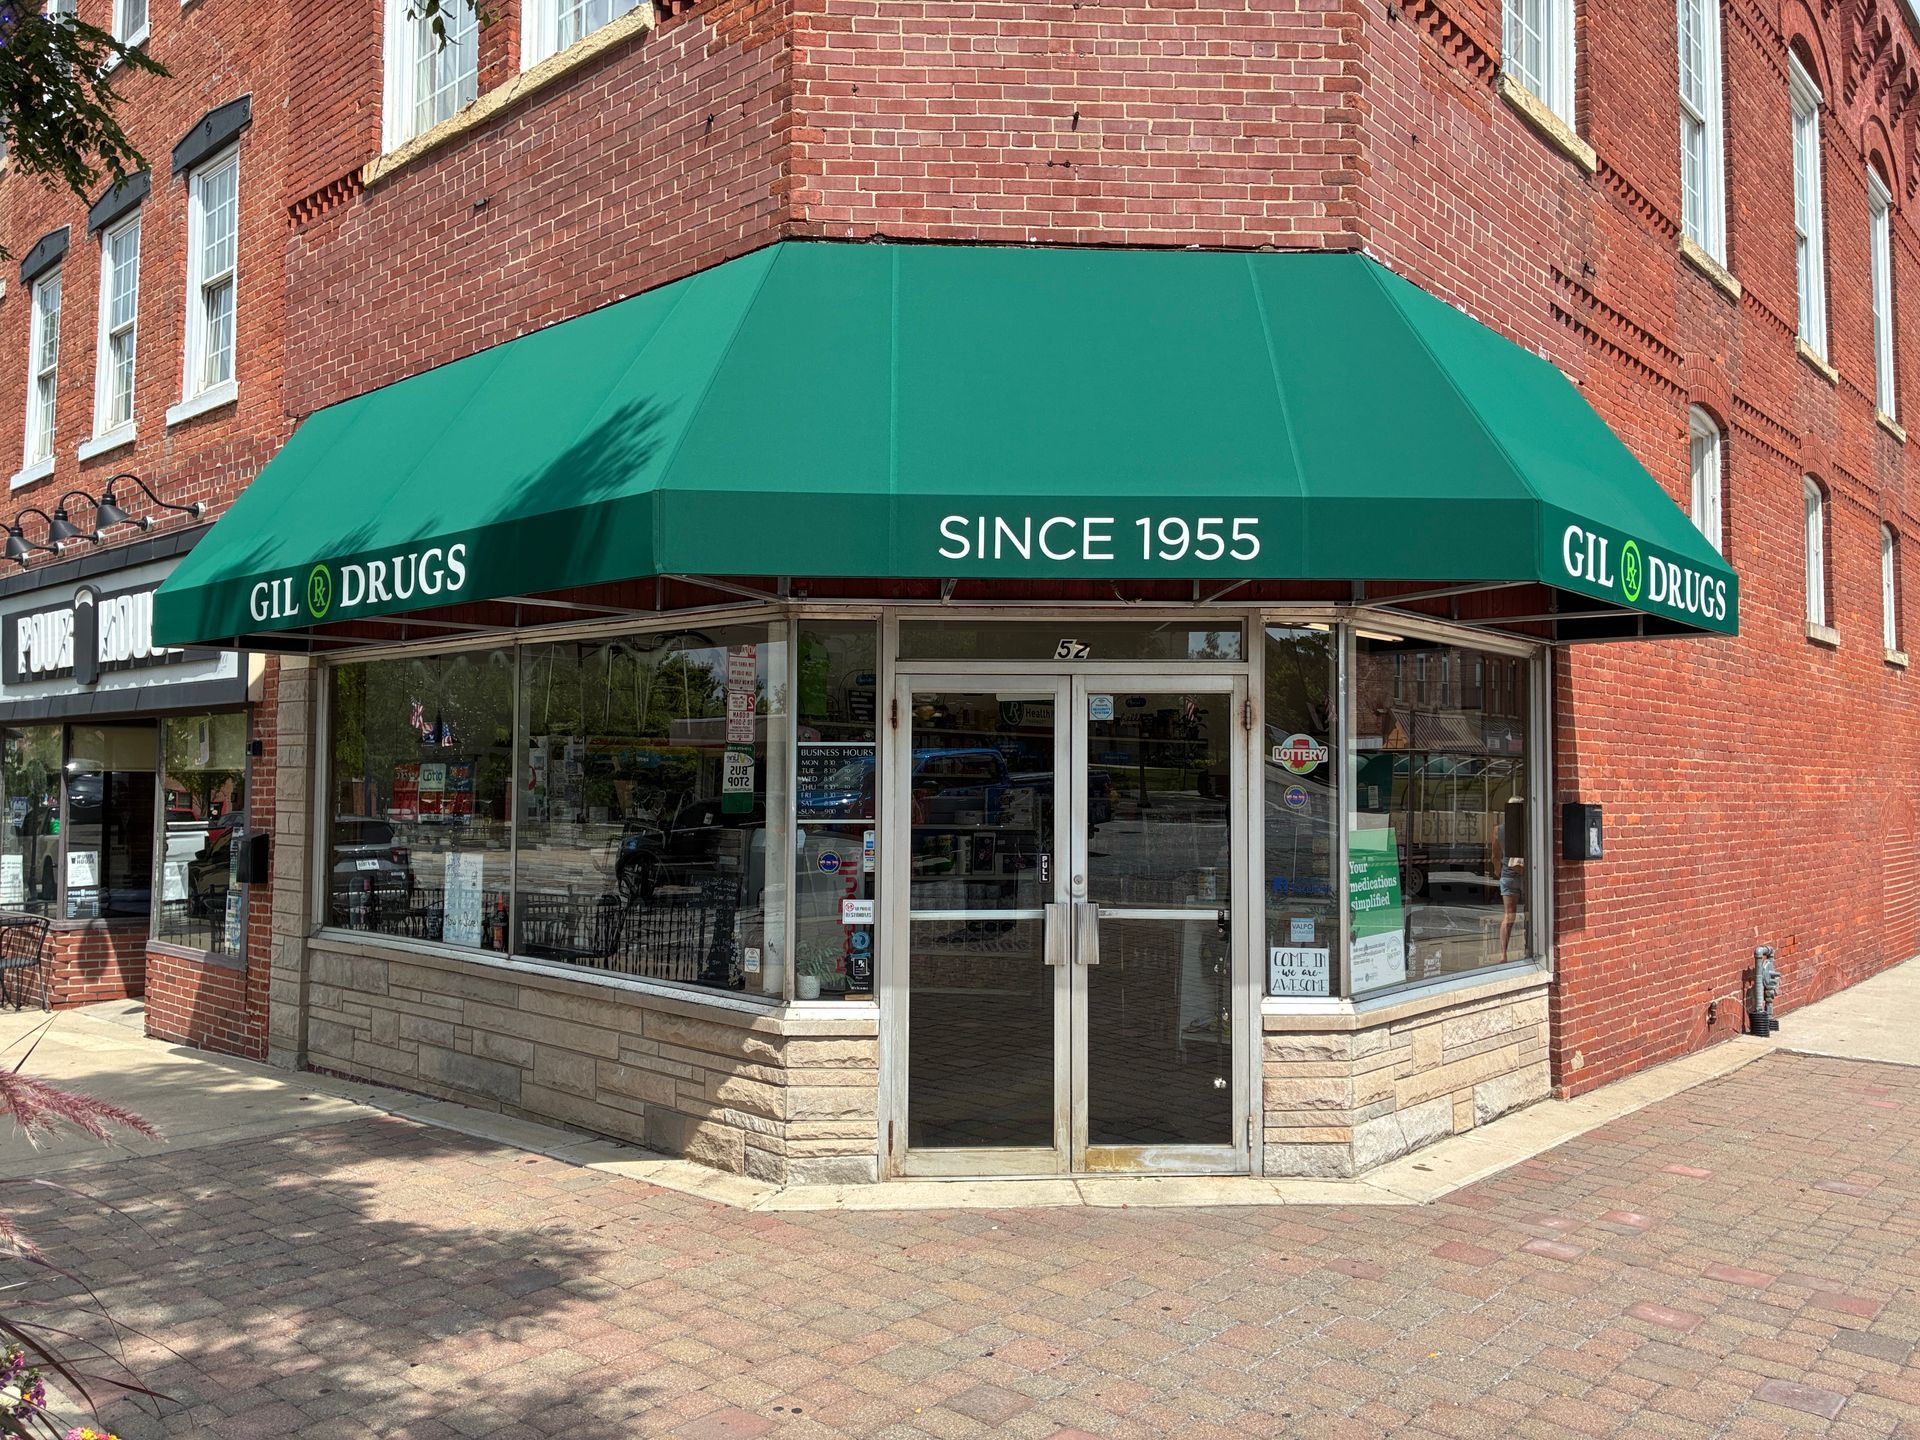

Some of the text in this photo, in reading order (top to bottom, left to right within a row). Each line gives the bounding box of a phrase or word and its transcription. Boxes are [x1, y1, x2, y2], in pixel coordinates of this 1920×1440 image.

[938, 515, 1261, 561] SINCE 1955
[1563, 525, 1614, 588] GIL
[1648, 555, 1726, 621] DRUGS
[250, 577, 299, 622] GIL
[340, 543, 466, 608] DRUGS
[17, 589, 185, 674] POUR HOU
[1057, 640, 1090, 659] 52
[1025, 708, 1051, 719] Health
[801, 749, 874, 757] BUSINESS HOURS
[1275, 748, 1326, 761] LOTTERY
[1349, 861, 1368, 874] Your
[1350, 874, 1397, 893] medications
[1351, 891, 1390, 911] simplified
[1274, 951, 1326, 967] COME IN
[1282, 969, 1319, 977] we are
[1272, 978, 1329, 992] AWESOME
